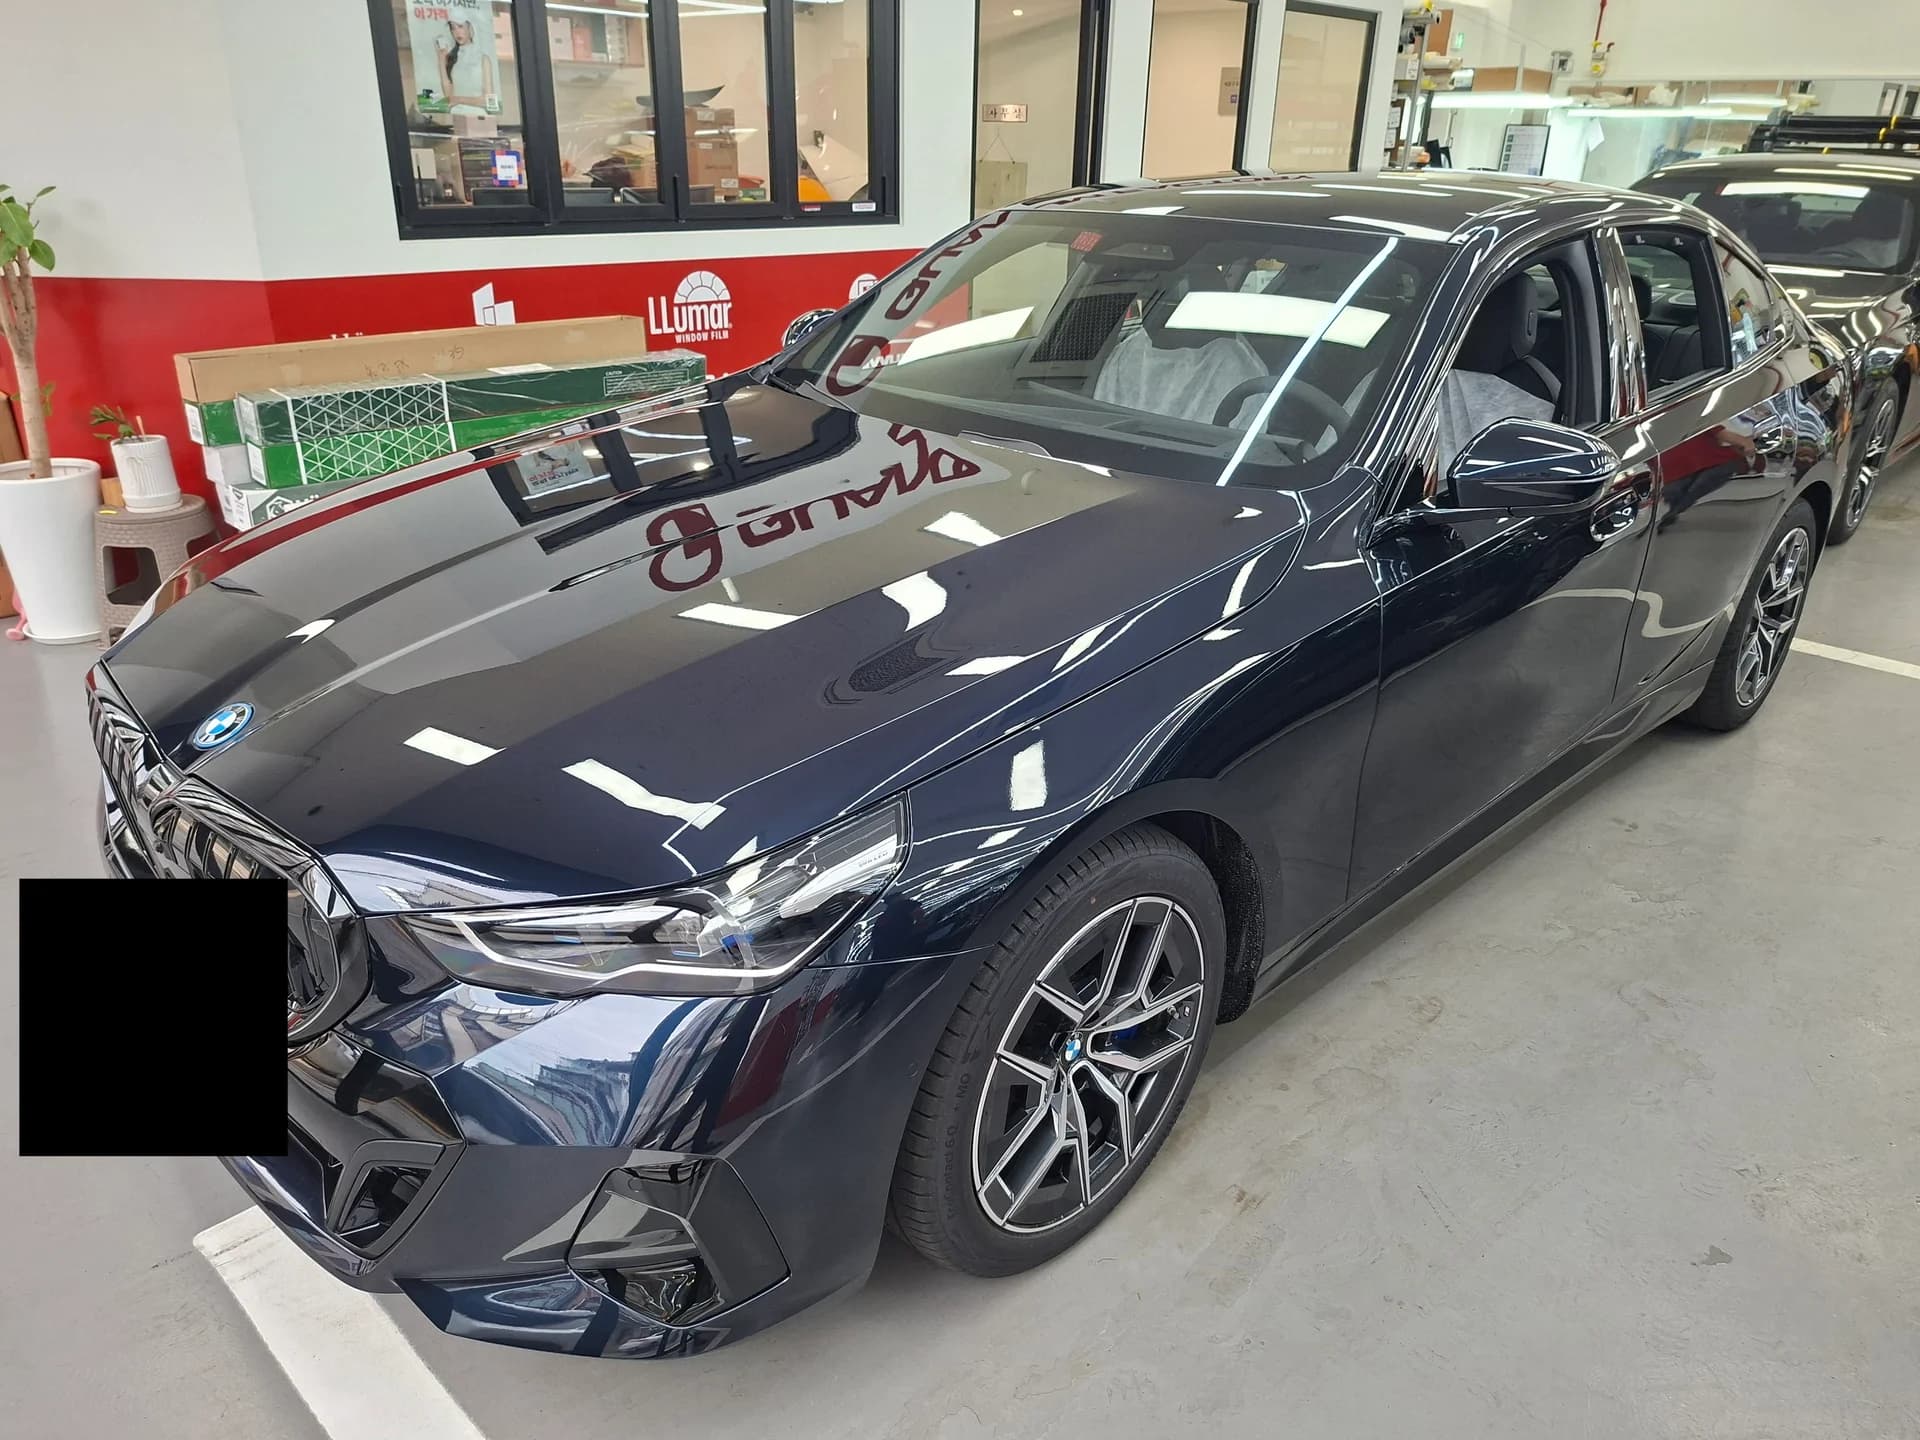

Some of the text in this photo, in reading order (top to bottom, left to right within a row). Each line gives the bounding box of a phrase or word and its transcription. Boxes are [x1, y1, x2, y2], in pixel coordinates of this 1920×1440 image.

[648, 296, 732, 335] LLumar
[675, 330, 729, 344] WINDOW FILM
